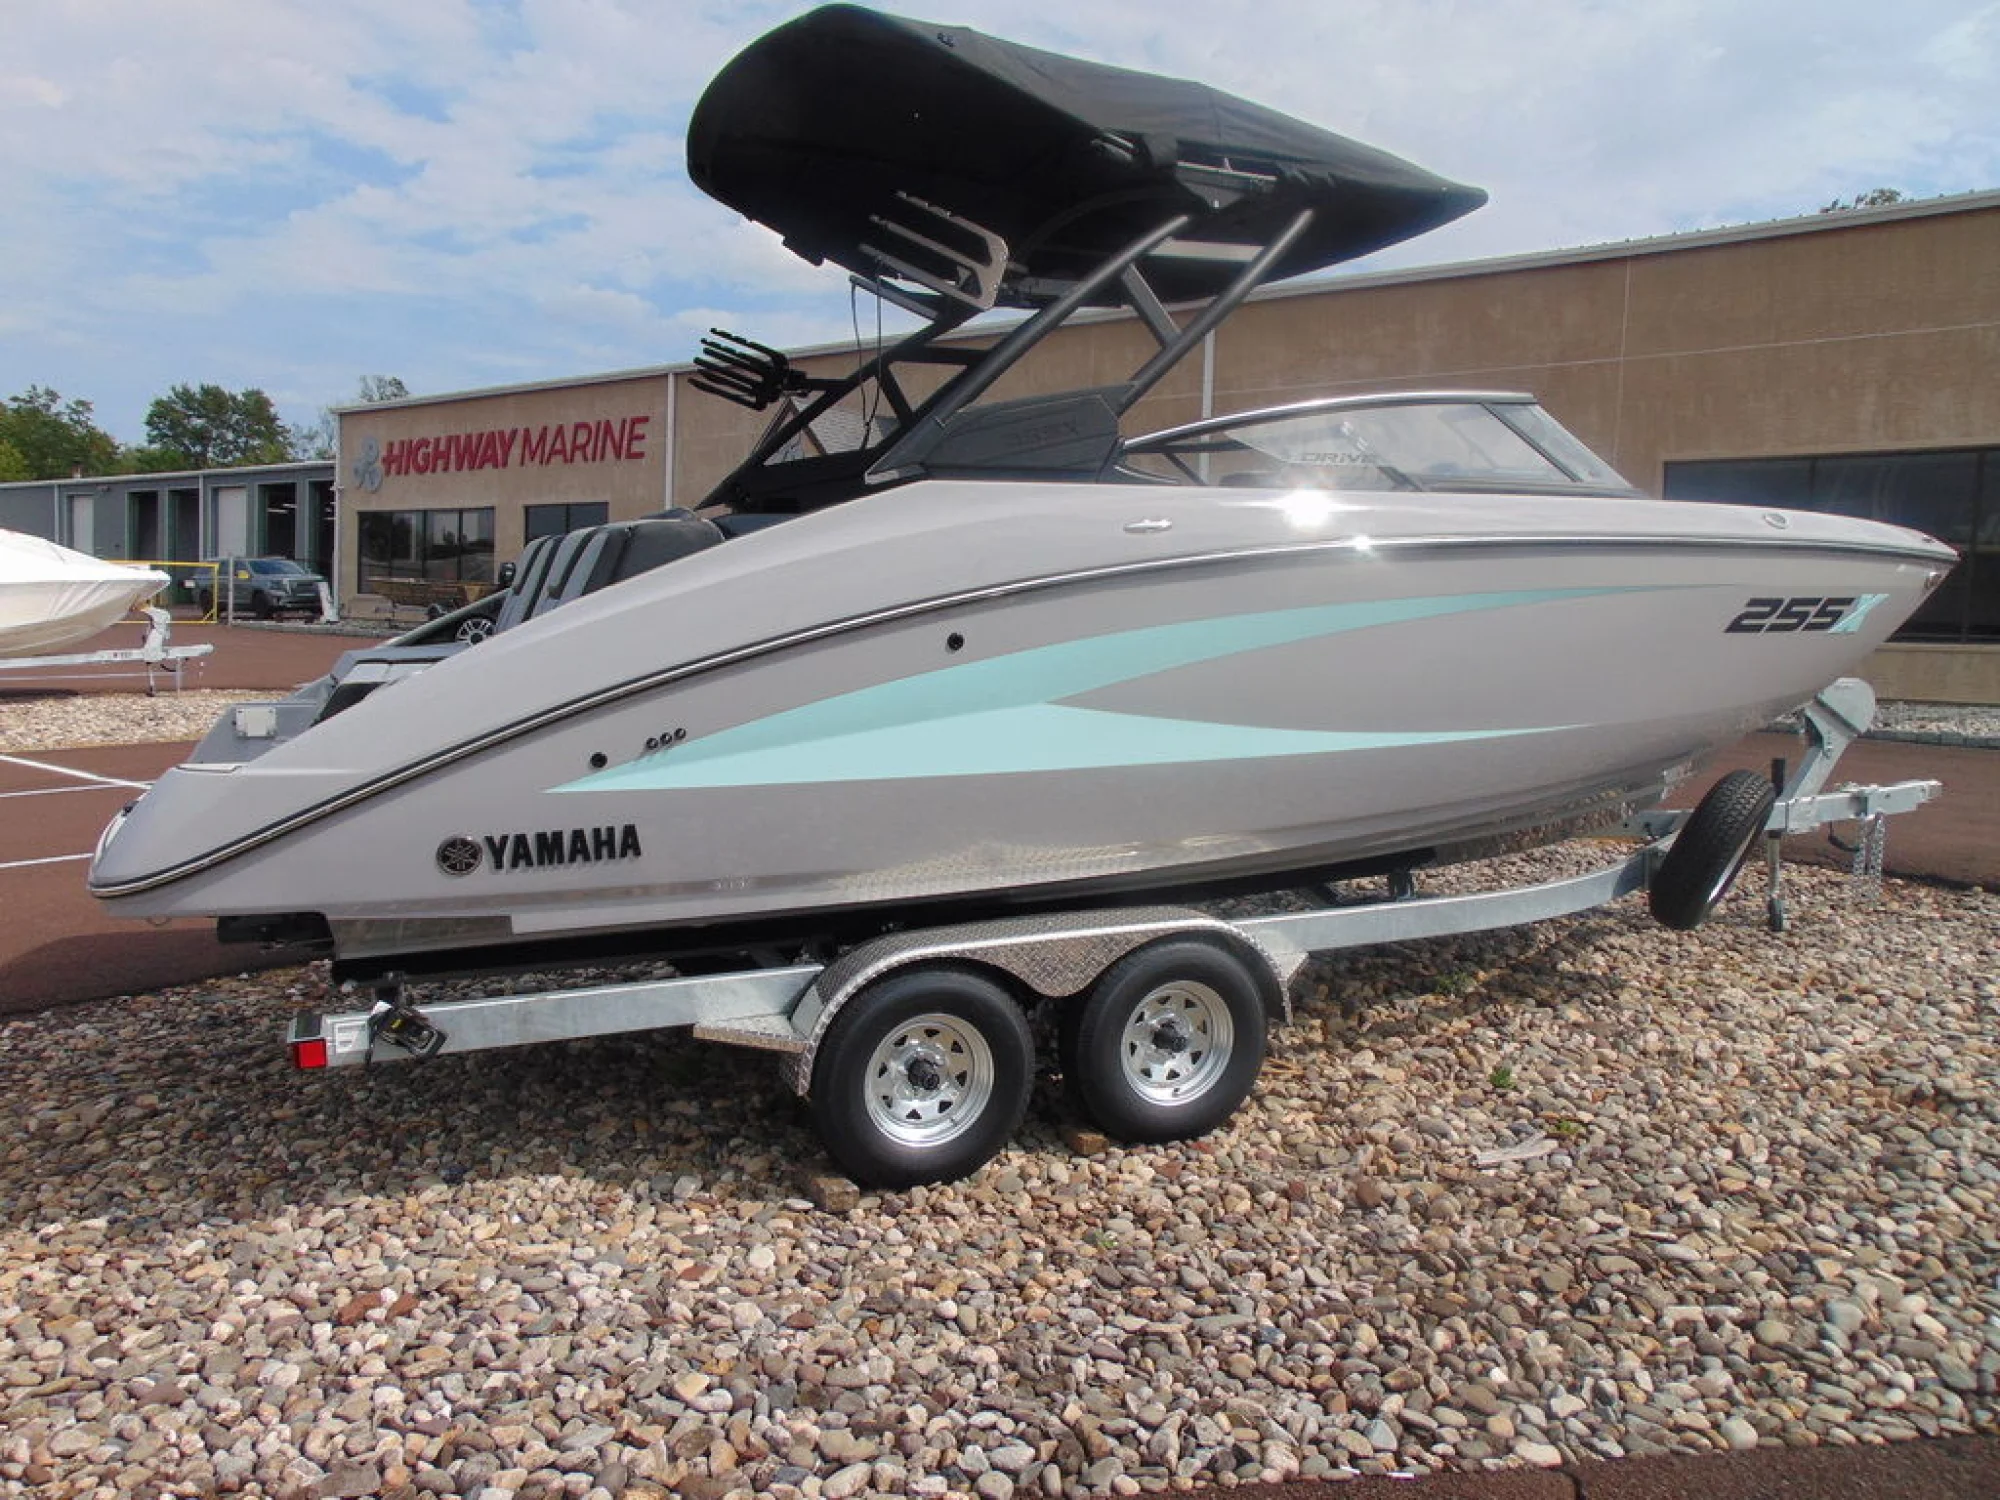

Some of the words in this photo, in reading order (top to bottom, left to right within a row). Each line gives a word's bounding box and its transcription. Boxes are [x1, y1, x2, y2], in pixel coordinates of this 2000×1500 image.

[382, 428, 519, 476] HIGHWAY
[519, 416, 650, 467] MARINE
[1724, 593, 1890, 633] 255X
[484, 824, 642, 870] YAMAHA
